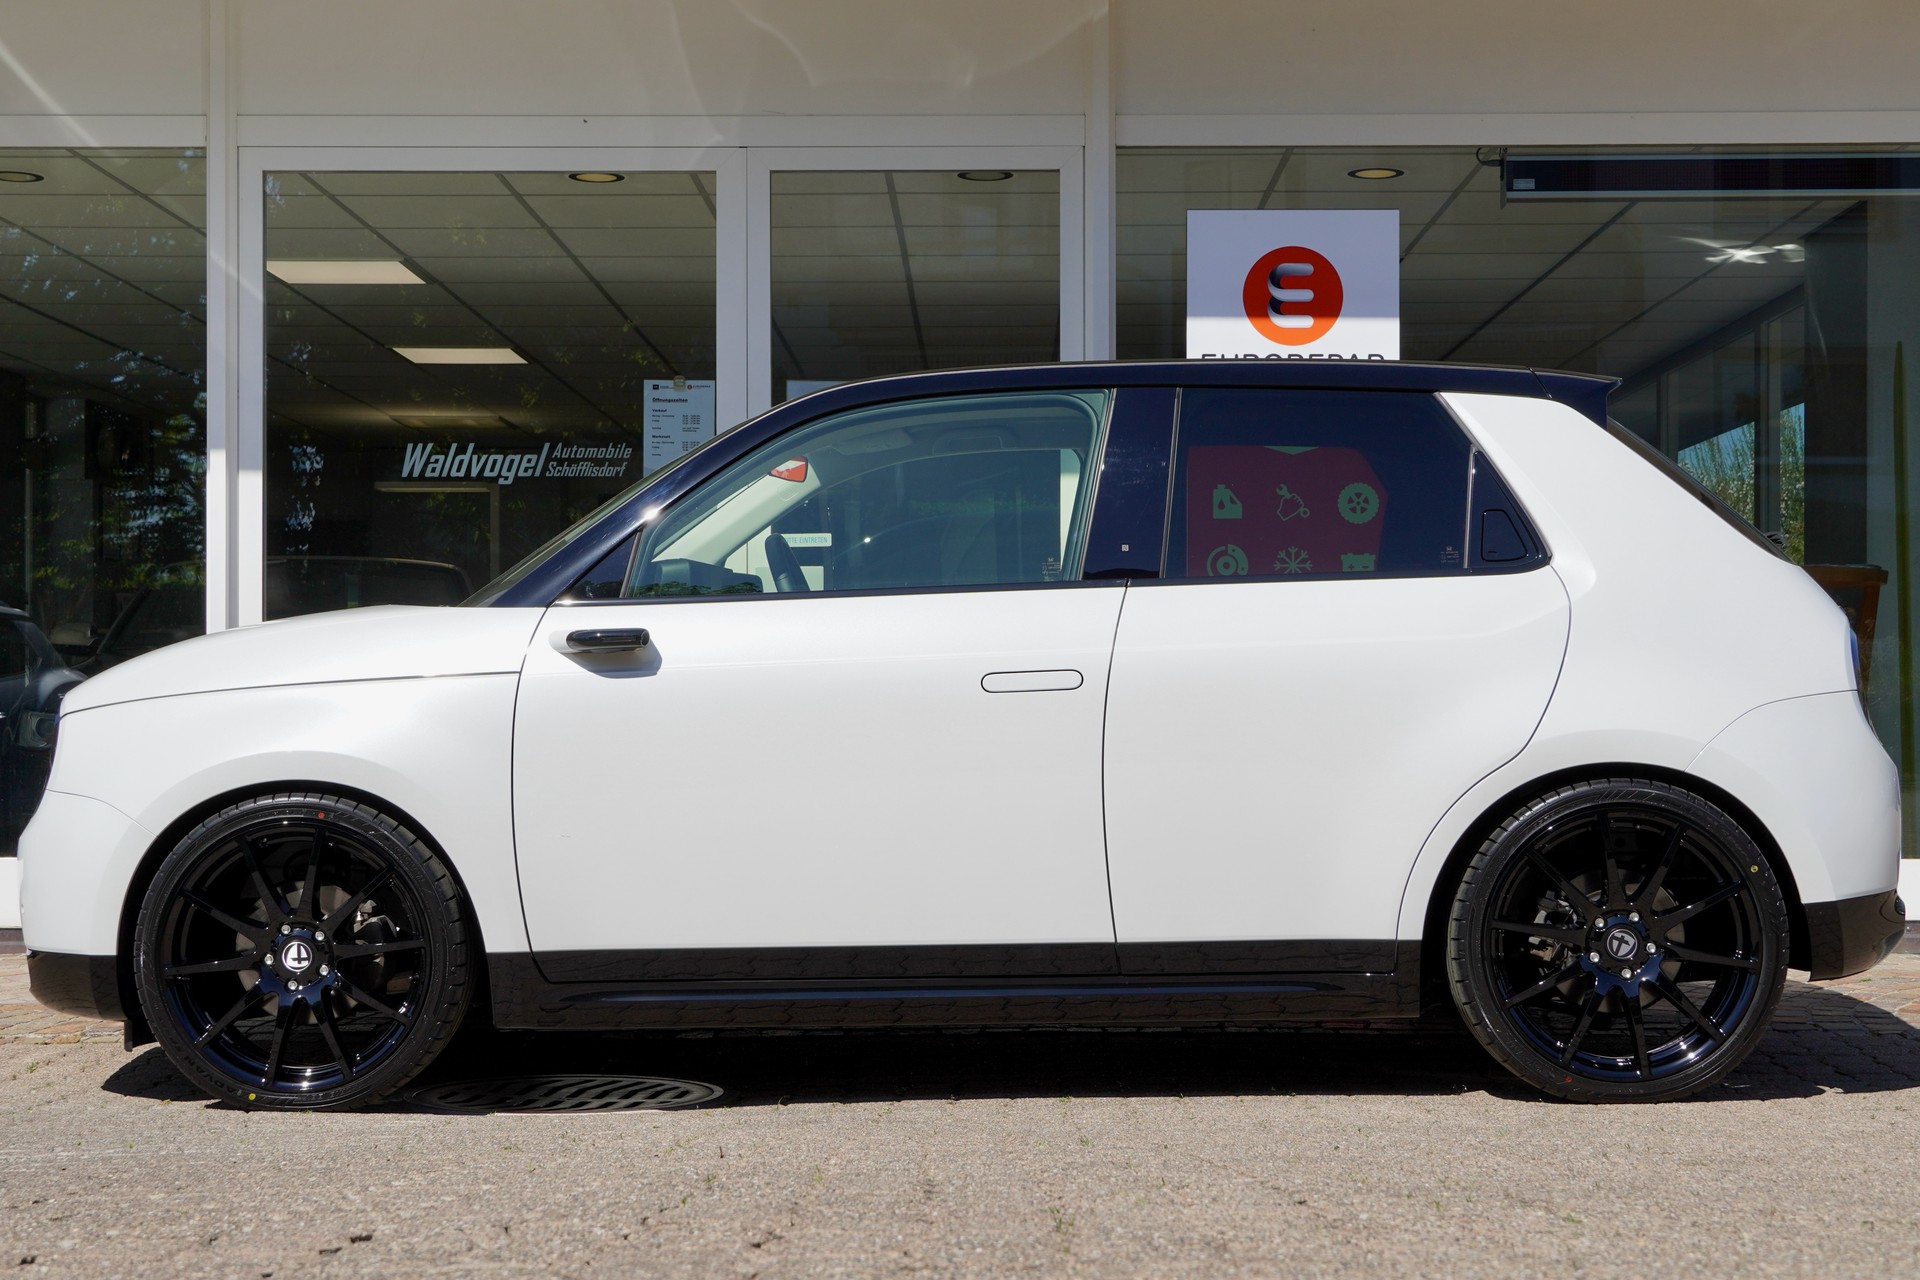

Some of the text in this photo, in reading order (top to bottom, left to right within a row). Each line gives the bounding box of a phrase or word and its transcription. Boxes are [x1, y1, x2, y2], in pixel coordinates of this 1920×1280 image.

[552, 442, 633, 459] Automobile
[401, 442, 550, 485] Waldvogel
[546, 461, 628, 477] Schöfflisdorf
